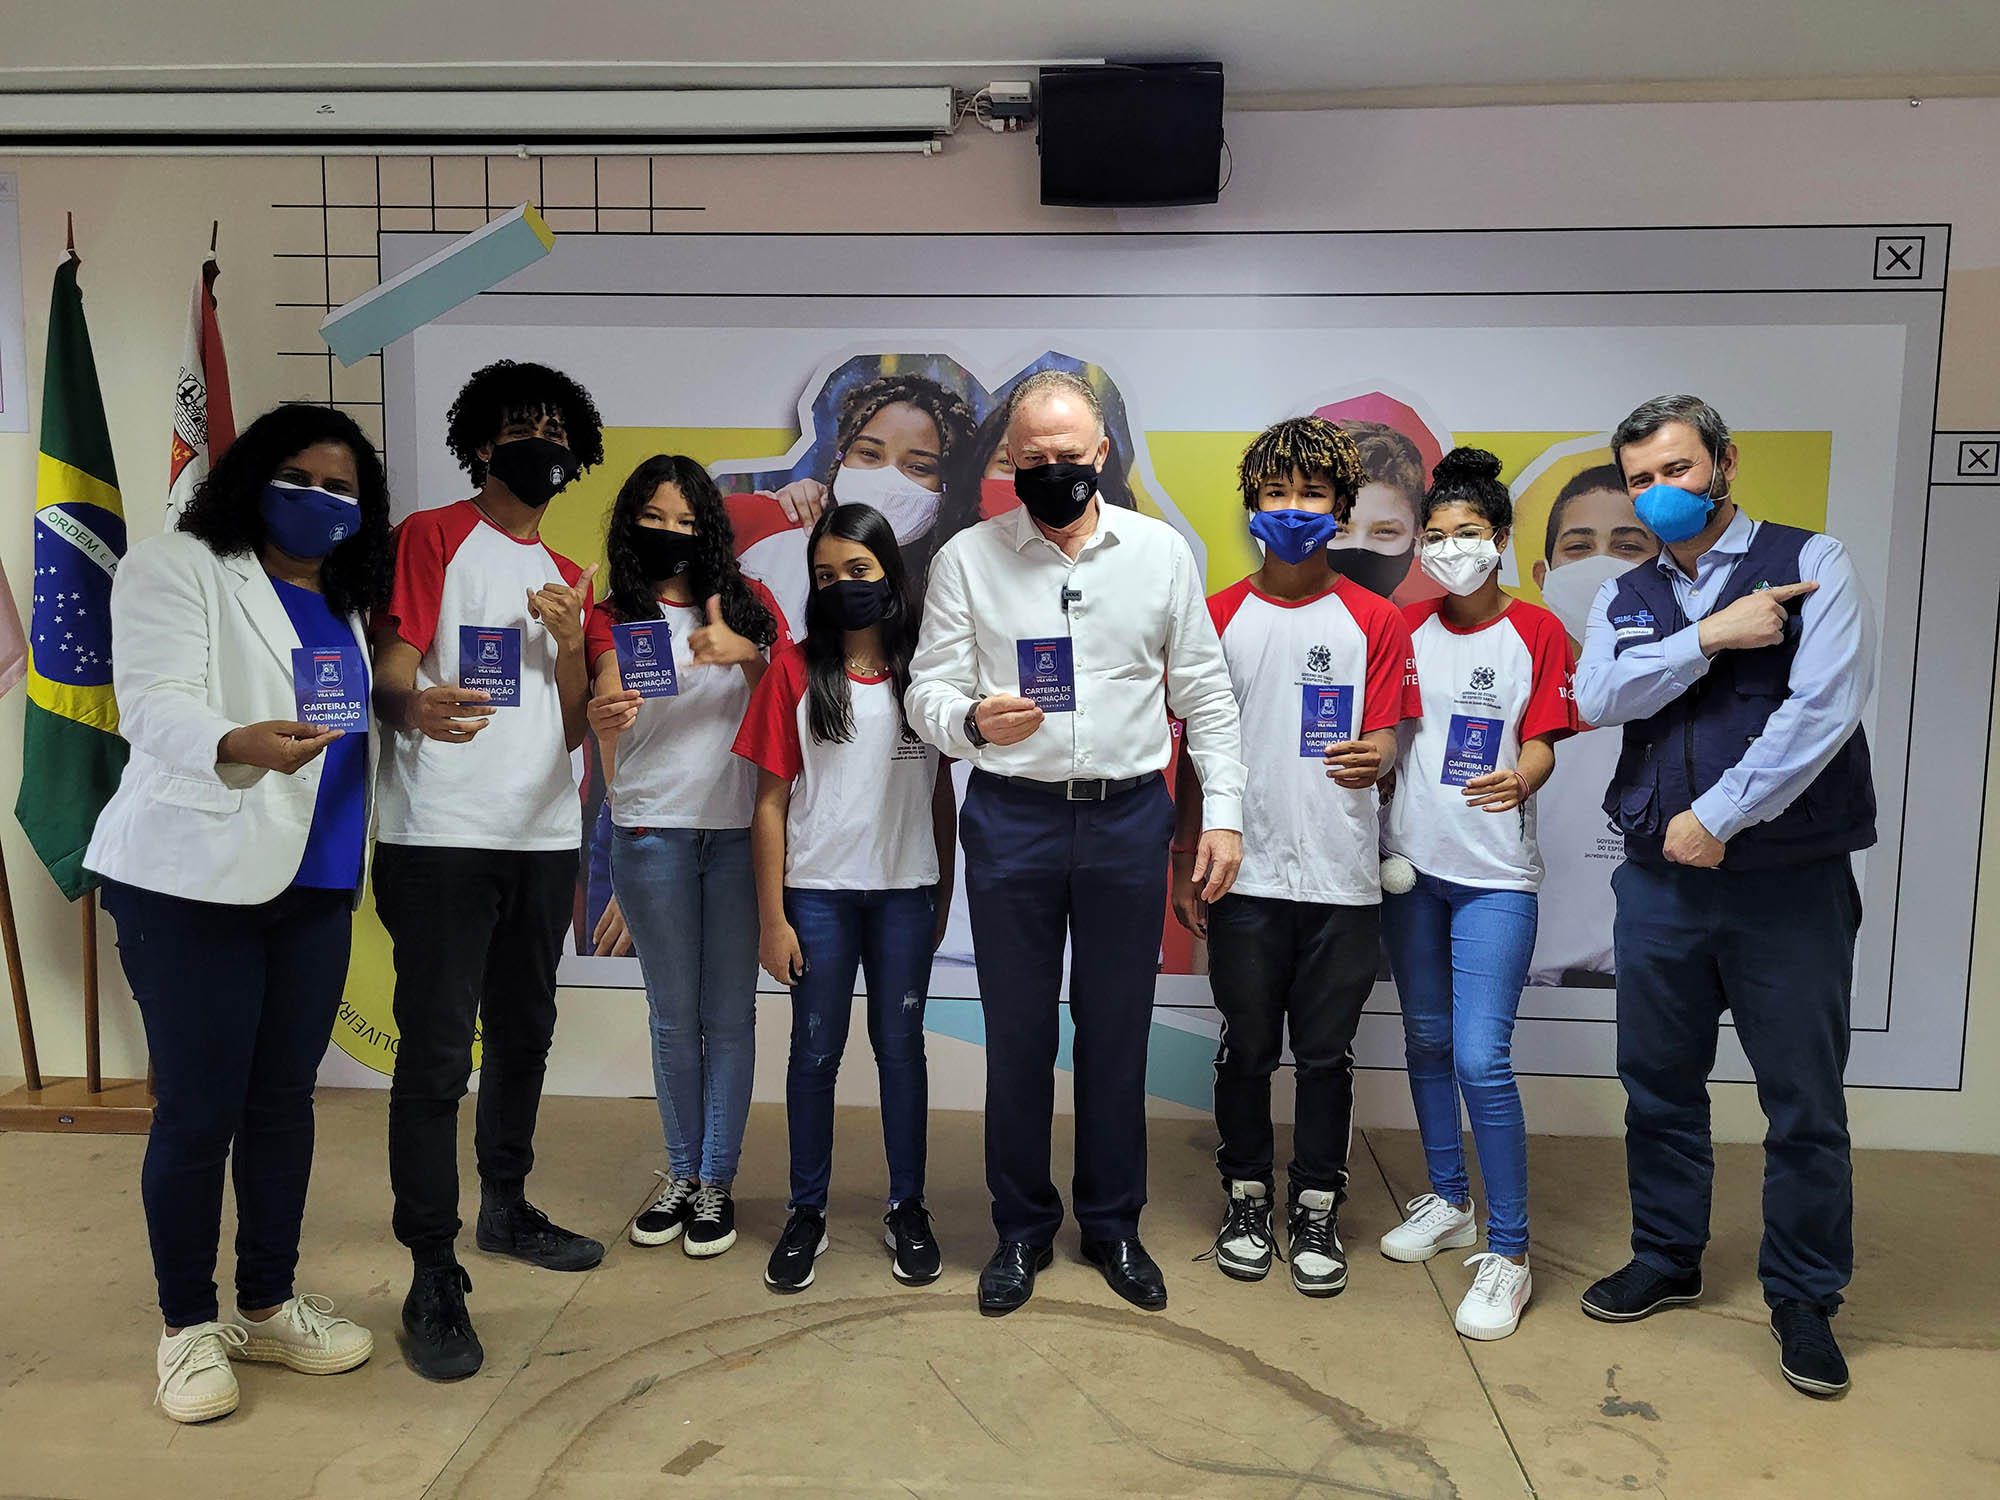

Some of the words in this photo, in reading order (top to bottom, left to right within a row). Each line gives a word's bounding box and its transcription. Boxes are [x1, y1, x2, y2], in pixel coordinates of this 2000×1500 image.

[48, 512, 100, 552] ORDEM
[625, 671, 660, 680] CARTEIRA
[464, 677, 504, 685] CARTEIRA
[627, 678, 672, 688] VACINAÇÃO
[1025, 686, 1060, 695] CARTEIRA
[303, 702, 347, 711] CARTEIRA
[306, 710, 360, 721] VACINAÇÃO
[1448, 760, 1482, 770] CARTEIRA
